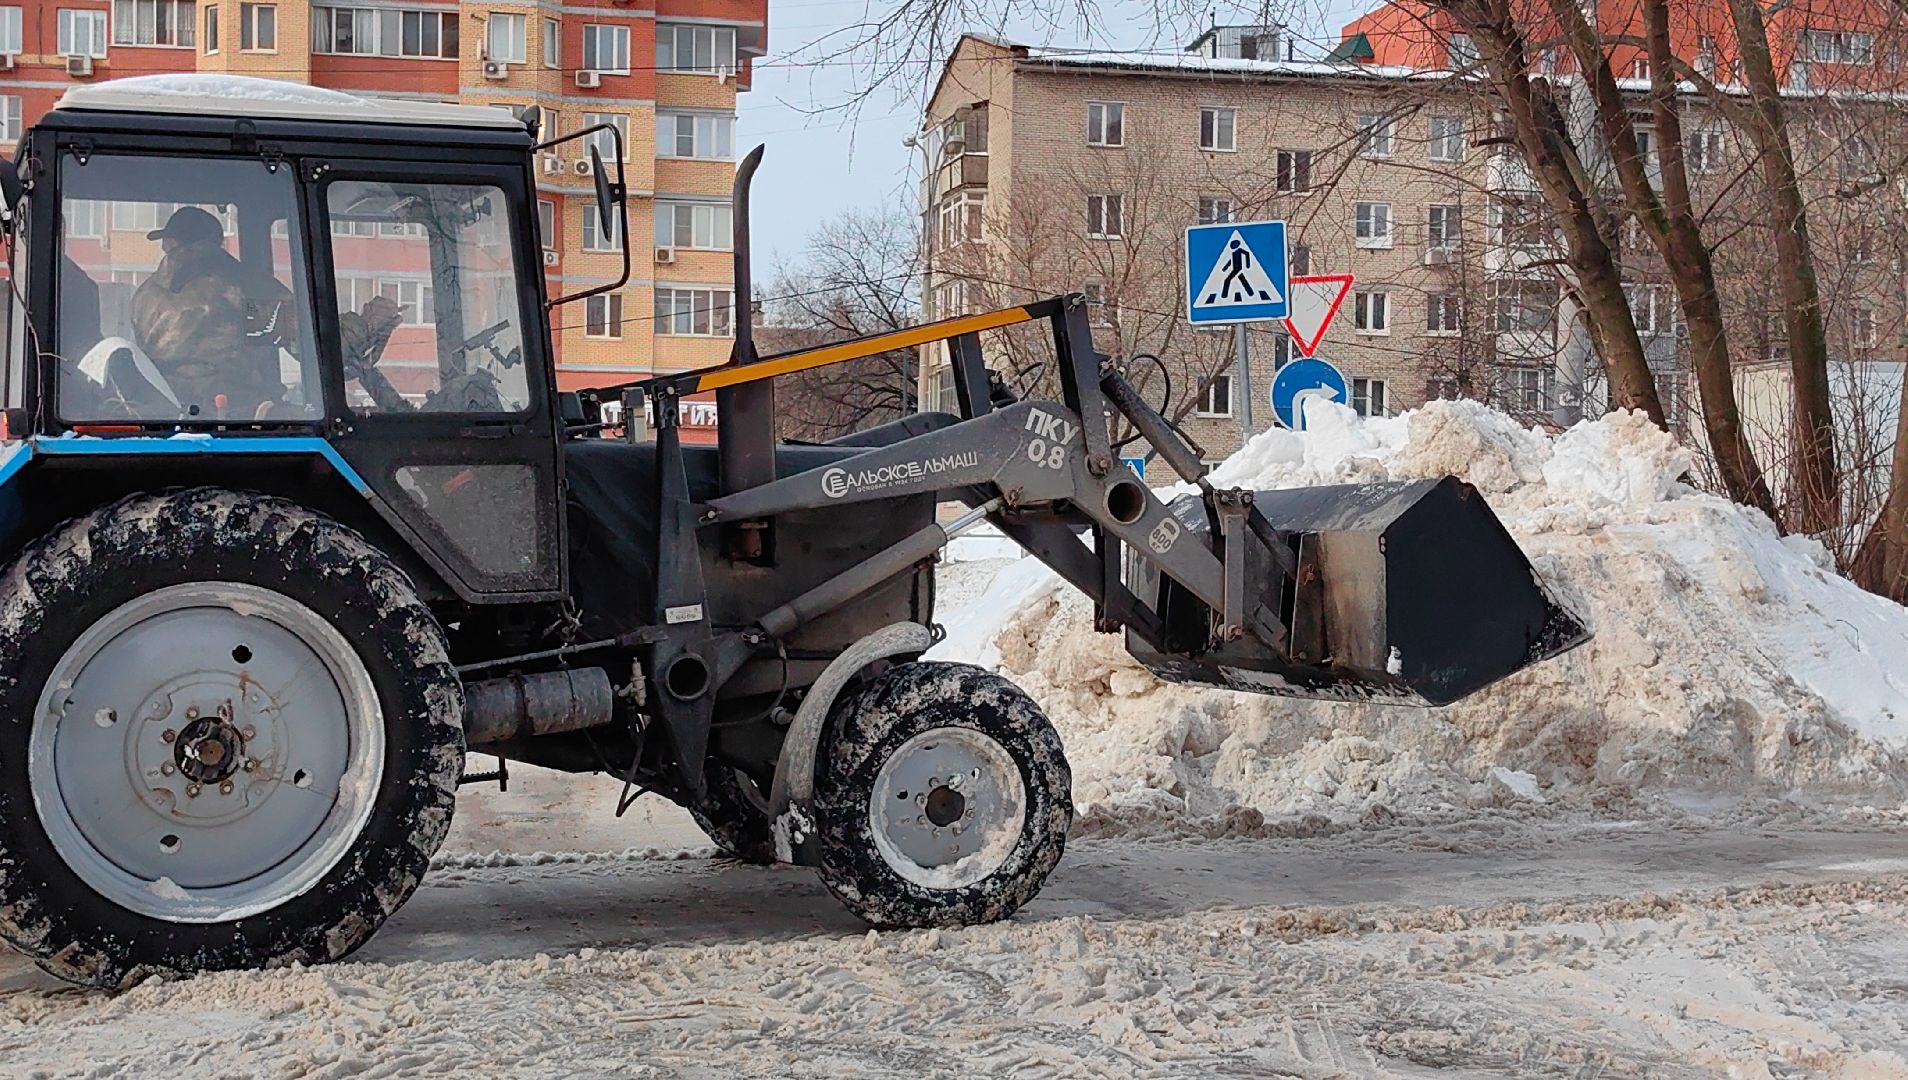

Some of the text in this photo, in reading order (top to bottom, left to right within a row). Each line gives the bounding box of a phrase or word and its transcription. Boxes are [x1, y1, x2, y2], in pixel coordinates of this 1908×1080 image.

[1025, 407, 1080, 445] ПКУ
[1028, 438, 1065, 470] 0,8
[1152, 529, 1172, 550] 800
